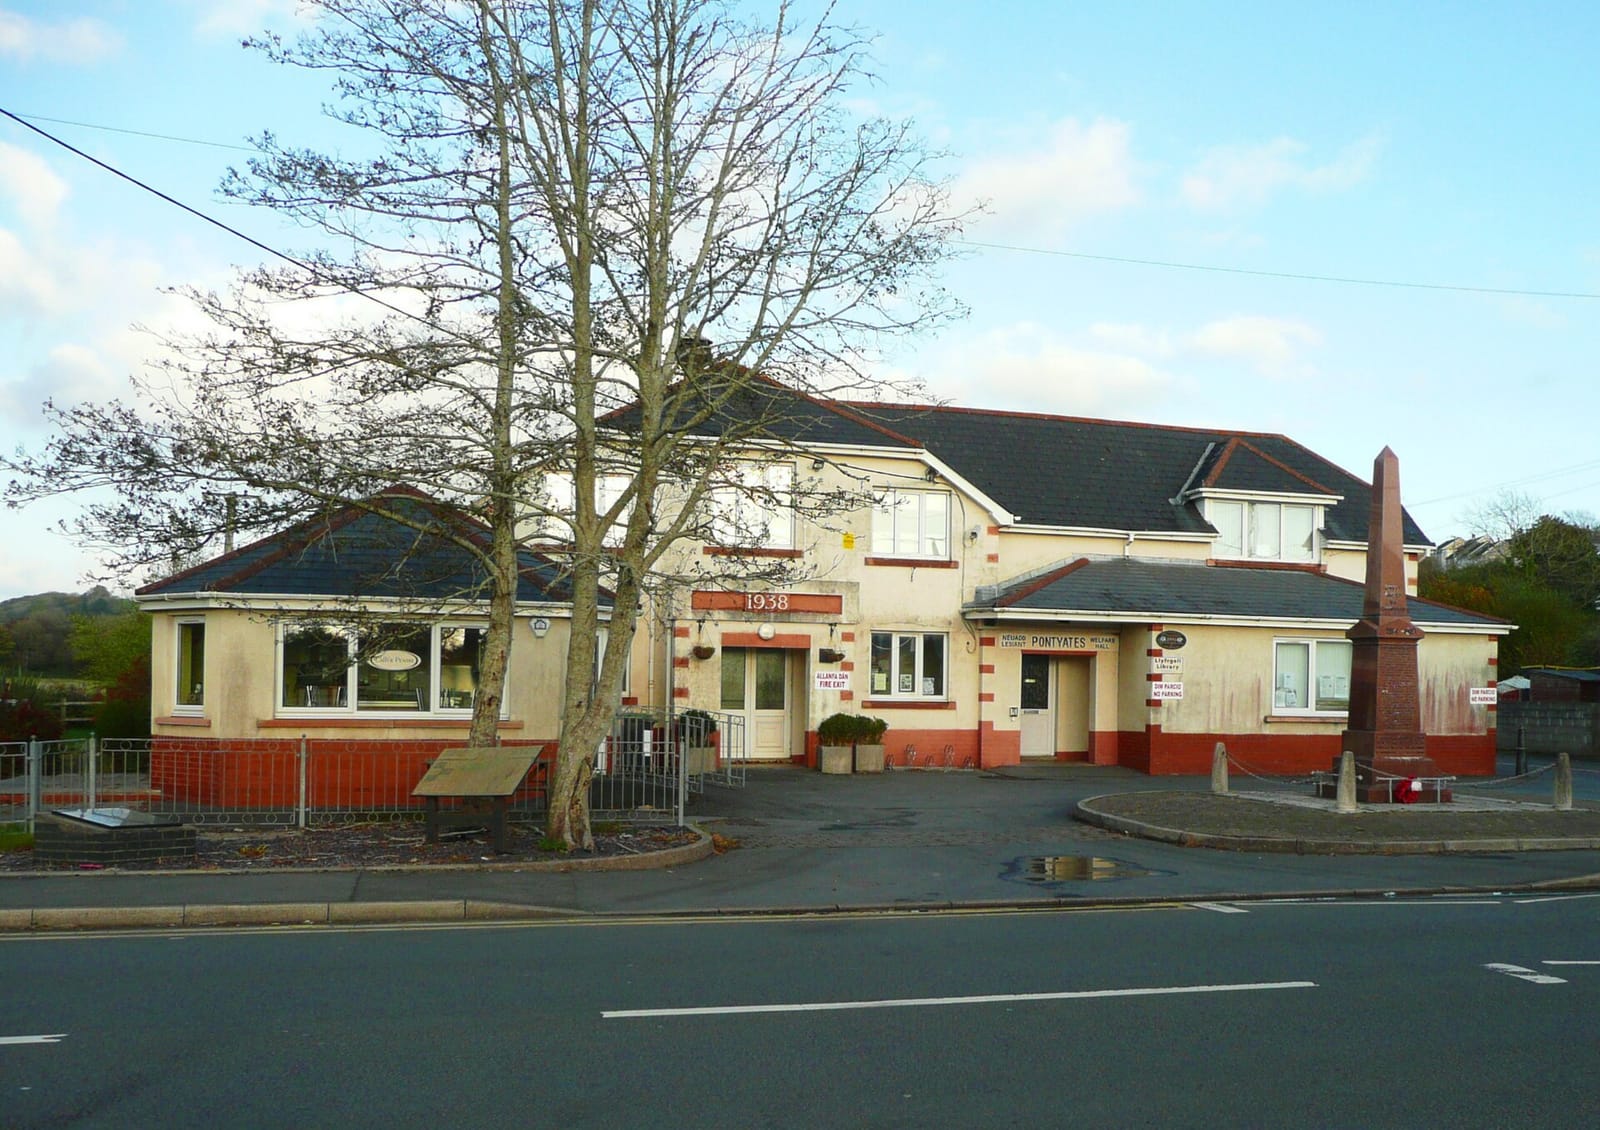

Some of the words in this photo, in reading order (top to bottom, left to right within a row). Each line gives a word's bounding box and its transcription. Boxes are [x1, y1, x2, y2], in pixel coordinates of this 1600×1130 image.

[747, 594, 788, 610] 1938
[1032, 636, 1086, 648] PONTYATES
[816, 672, 838, 680] ALLANFA
[819, 680, 831, 688] FIRE
[832, 680, 846, 688] EXIT
[1153, 690, 1161, 698] NO
[1162, 690, 1183, 698] PARKING
